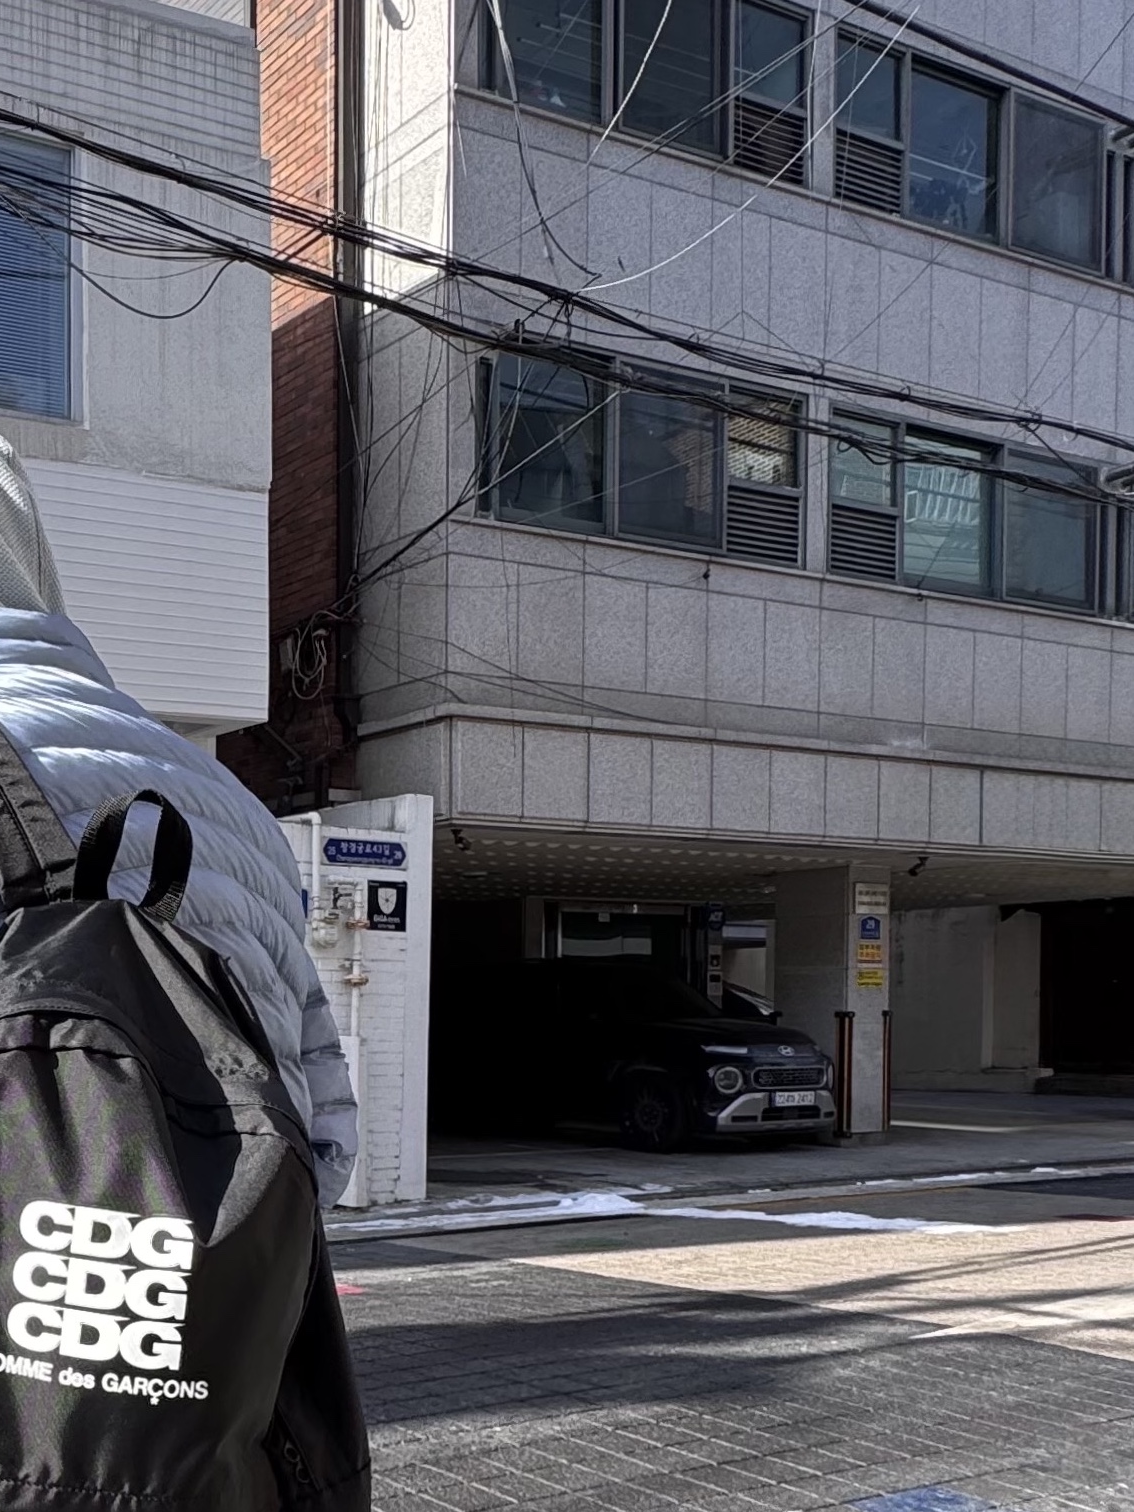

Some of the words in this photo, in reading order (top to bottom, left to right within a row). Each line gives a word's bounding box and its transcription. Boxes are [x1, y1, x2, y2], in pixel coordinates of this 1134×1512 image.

[19, 1200, 194, 1270] CDG
[12, 1251, 192, 1320] CDG
[6, 1301, 186, 1371] CDG
[58, 1367, 96, 1389] des
[101, 1372, 209, 1405] GARÇONS
